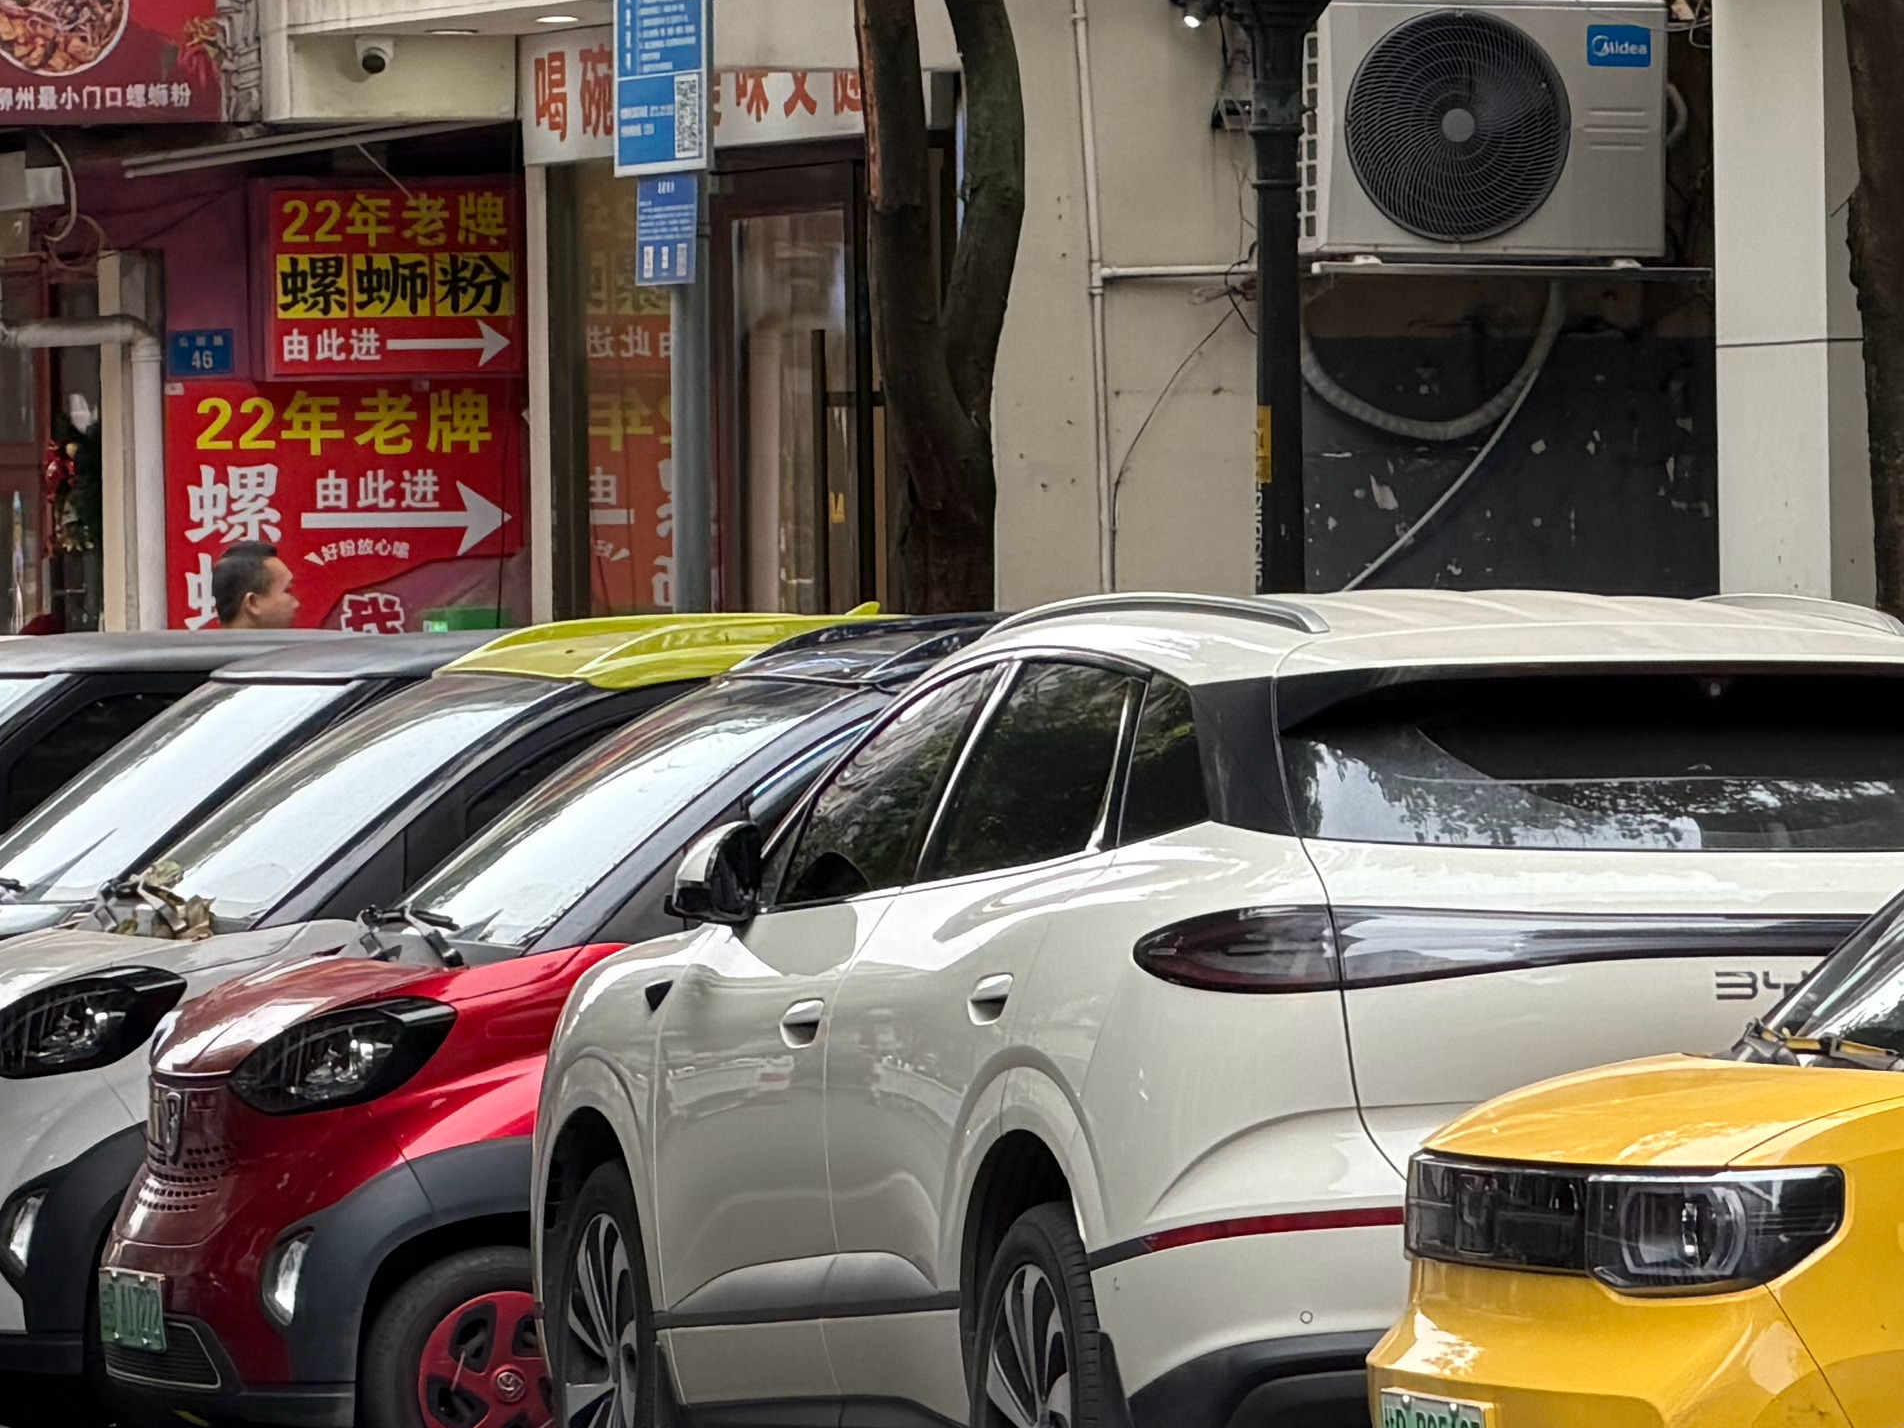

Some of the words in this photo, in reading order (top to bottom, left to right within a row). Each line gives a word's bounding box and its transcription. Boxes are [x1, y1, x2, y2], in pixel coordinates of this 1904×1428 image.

[281, 192, 508, 248] 22年老牌
[278, 254, 510, 316] 螺蛳粉
[191, 349, 214, 370] 46
[282, 328, 382, 362] 由此进
[195, 388, 492, 456] 22年老牌
[315, 469, 441, 510] 由此进
